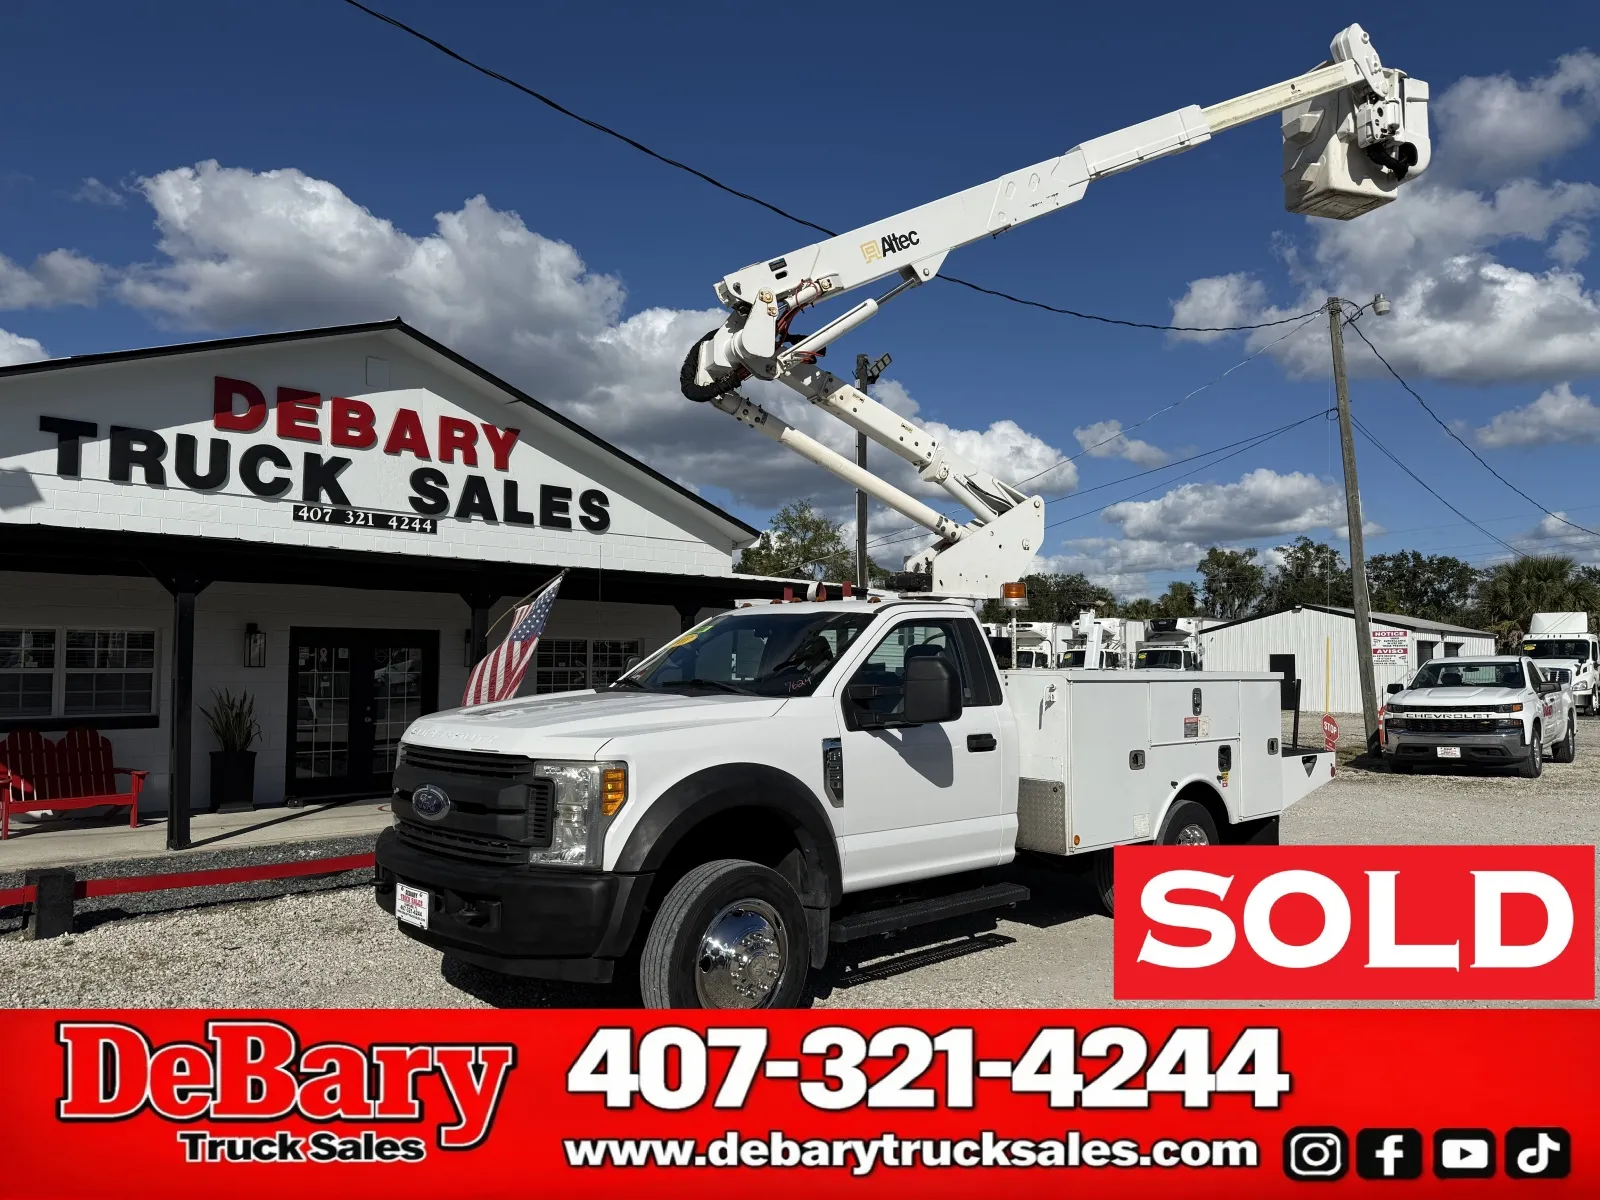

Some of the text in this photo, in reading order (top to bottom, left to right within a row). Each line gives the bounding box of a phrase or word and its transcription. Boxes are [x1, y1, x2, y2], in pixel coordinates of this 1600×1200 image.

[880, 230, 920, 257] Altec
[213, 376, 521, 472] DEBARY
[39, 415, 611, 533] TRUCK SALES
[298, 506, 432, 532] 407 321 4244
[1323, 721, 1337, 735] STOP
